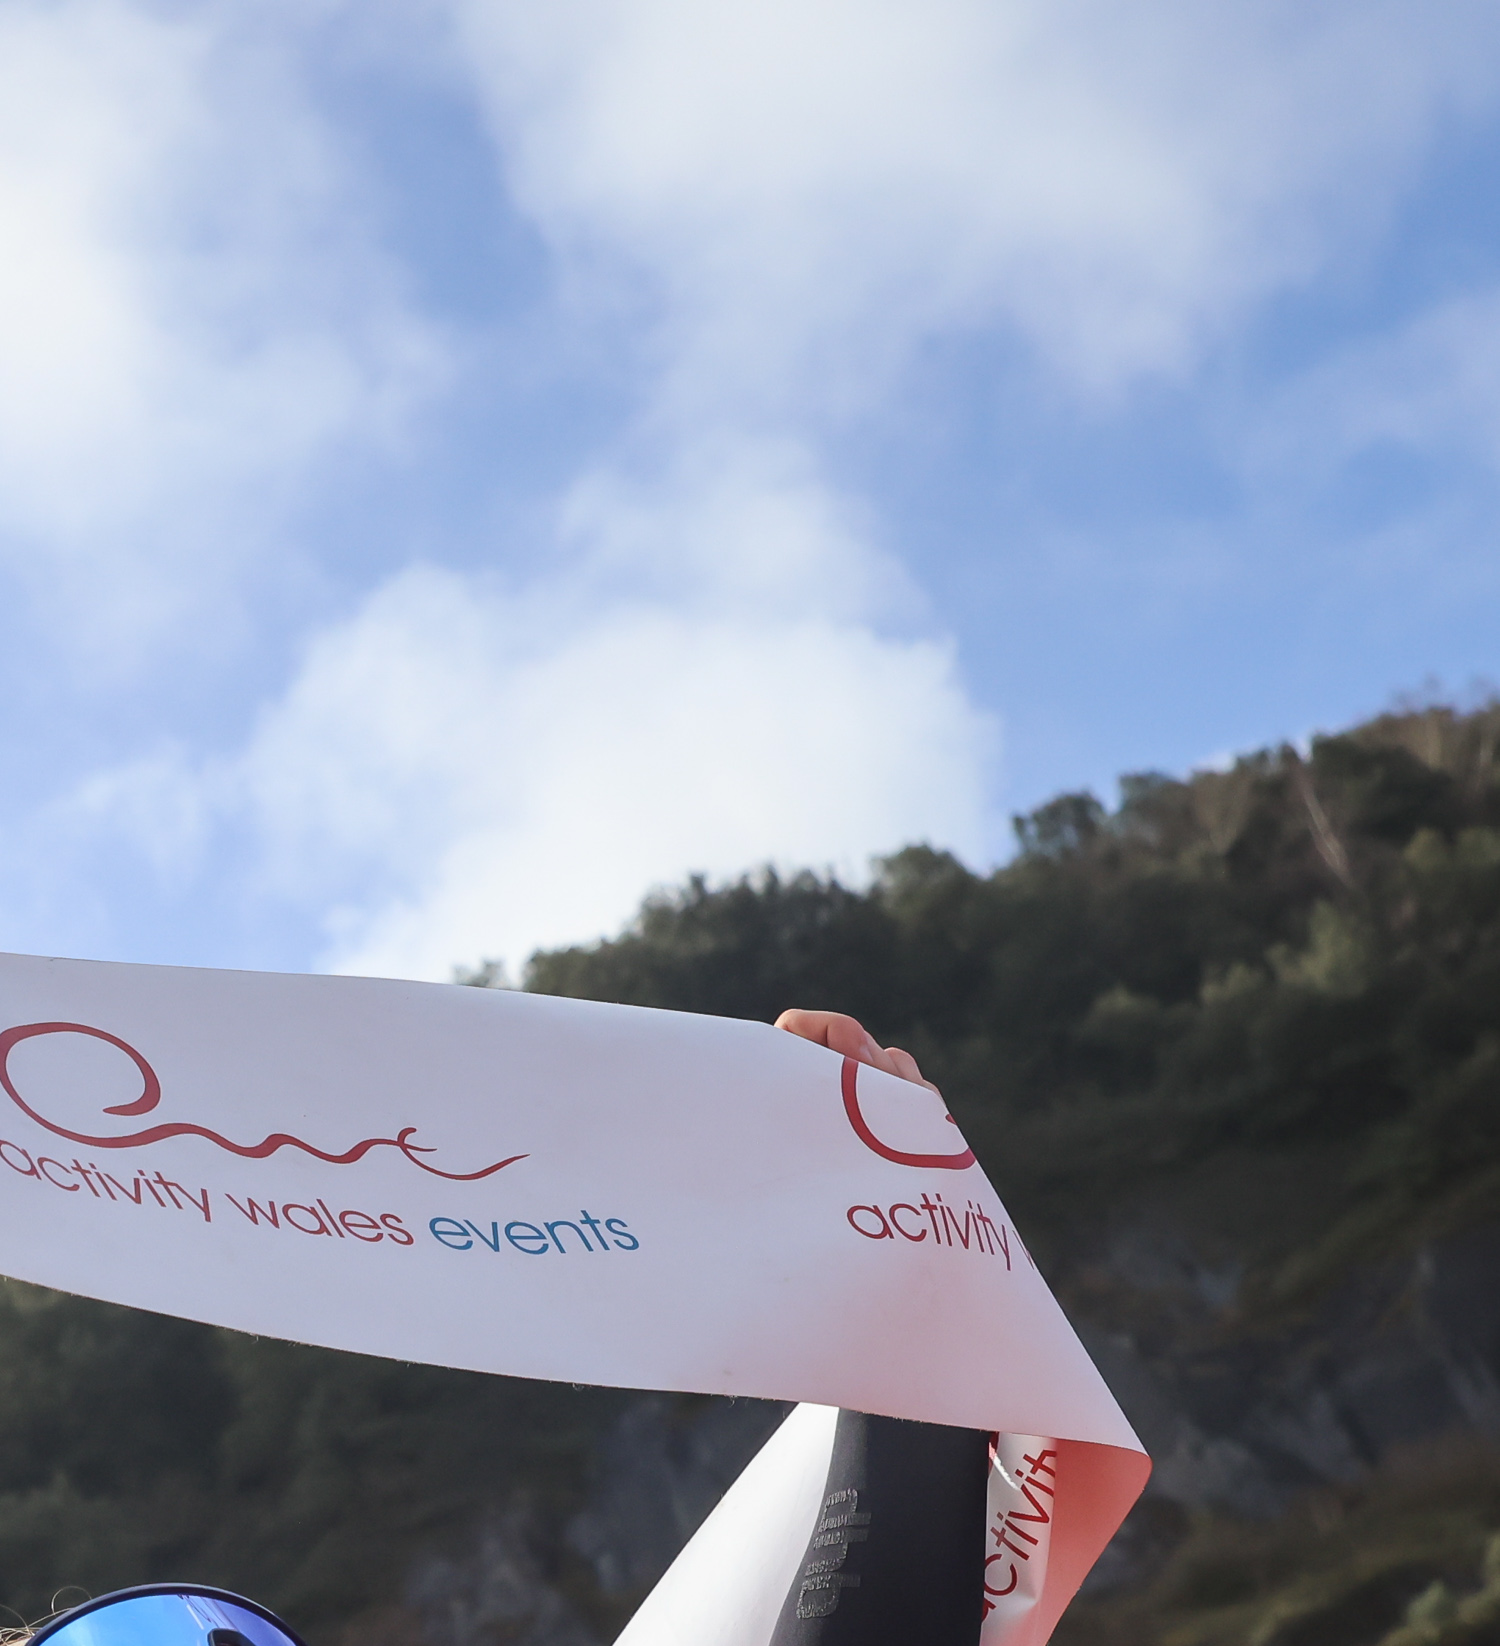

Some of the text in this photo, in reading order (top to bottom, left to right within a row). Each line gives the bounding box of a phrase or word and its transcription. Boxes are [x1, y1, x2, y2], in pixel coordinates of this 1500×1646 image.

[225, 1190, 415, 1248] wales
[428, 1209, 641, 1256] events
[846, 1192, 1011, 1272] activity
[981, 1448, 1057, 1623] ctivit
